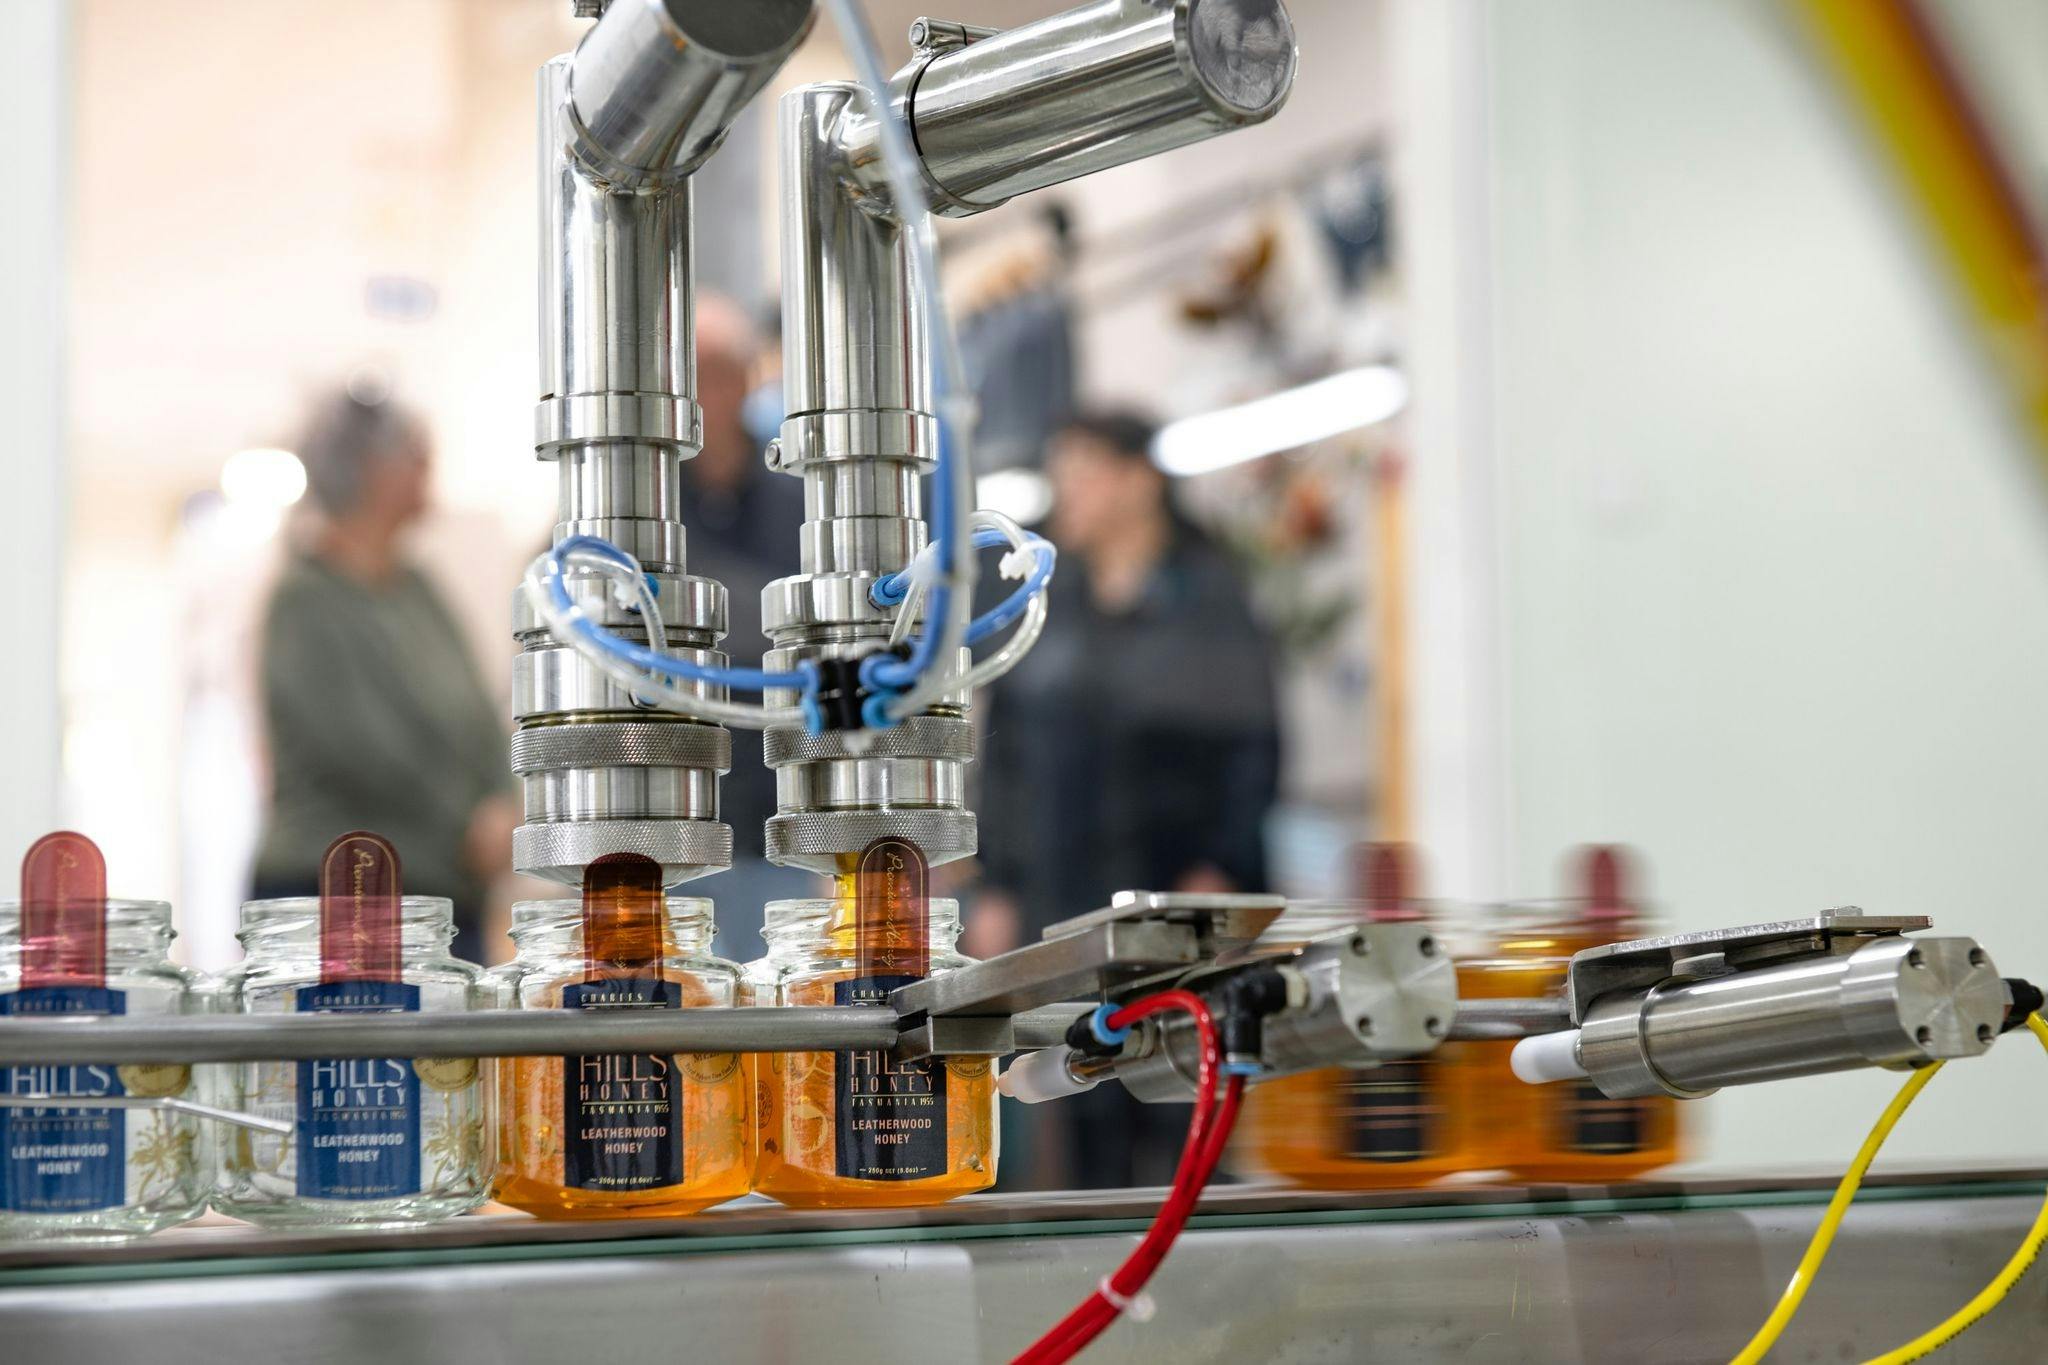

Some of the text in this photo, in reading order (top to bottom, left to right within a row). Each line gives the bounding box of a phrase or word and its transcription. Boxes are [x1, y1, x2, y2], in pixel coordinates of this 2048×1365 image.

[581, 993, 643, 1002] CHARLES
[851, 990, 891, 998] CHAR
[580, 1054, 667, 1082] HILLS
[851, 1050, 932, 1075] HIL
[12, 1065, 111, 1097] HILLS
[313, 1059, 406, 1089] HILLS
[580, 1083, 667, 1101] HONEY
[851, 1076, 933, 1093] HONEY
[312, 1088, 407, 1107] HONEY
[852, 1097, 934, 1107] TASMANIA 1955
[852, 1118, 932, 1130] LEATHERWOOD
[313, 1132, 405, 1148] LEATHERWOOD
[581, 1126, 667, 1140] LEATHERWOOD
[874, 1134, 910, 1145] HONEY
[12, 1143, 109, 1160] LEATHERWOOD
[605, 1142, 644, 1154] HONEY
[338, 1149, 380, 1163] HONEY
[37, 1161, 82, 1175] HONEY
